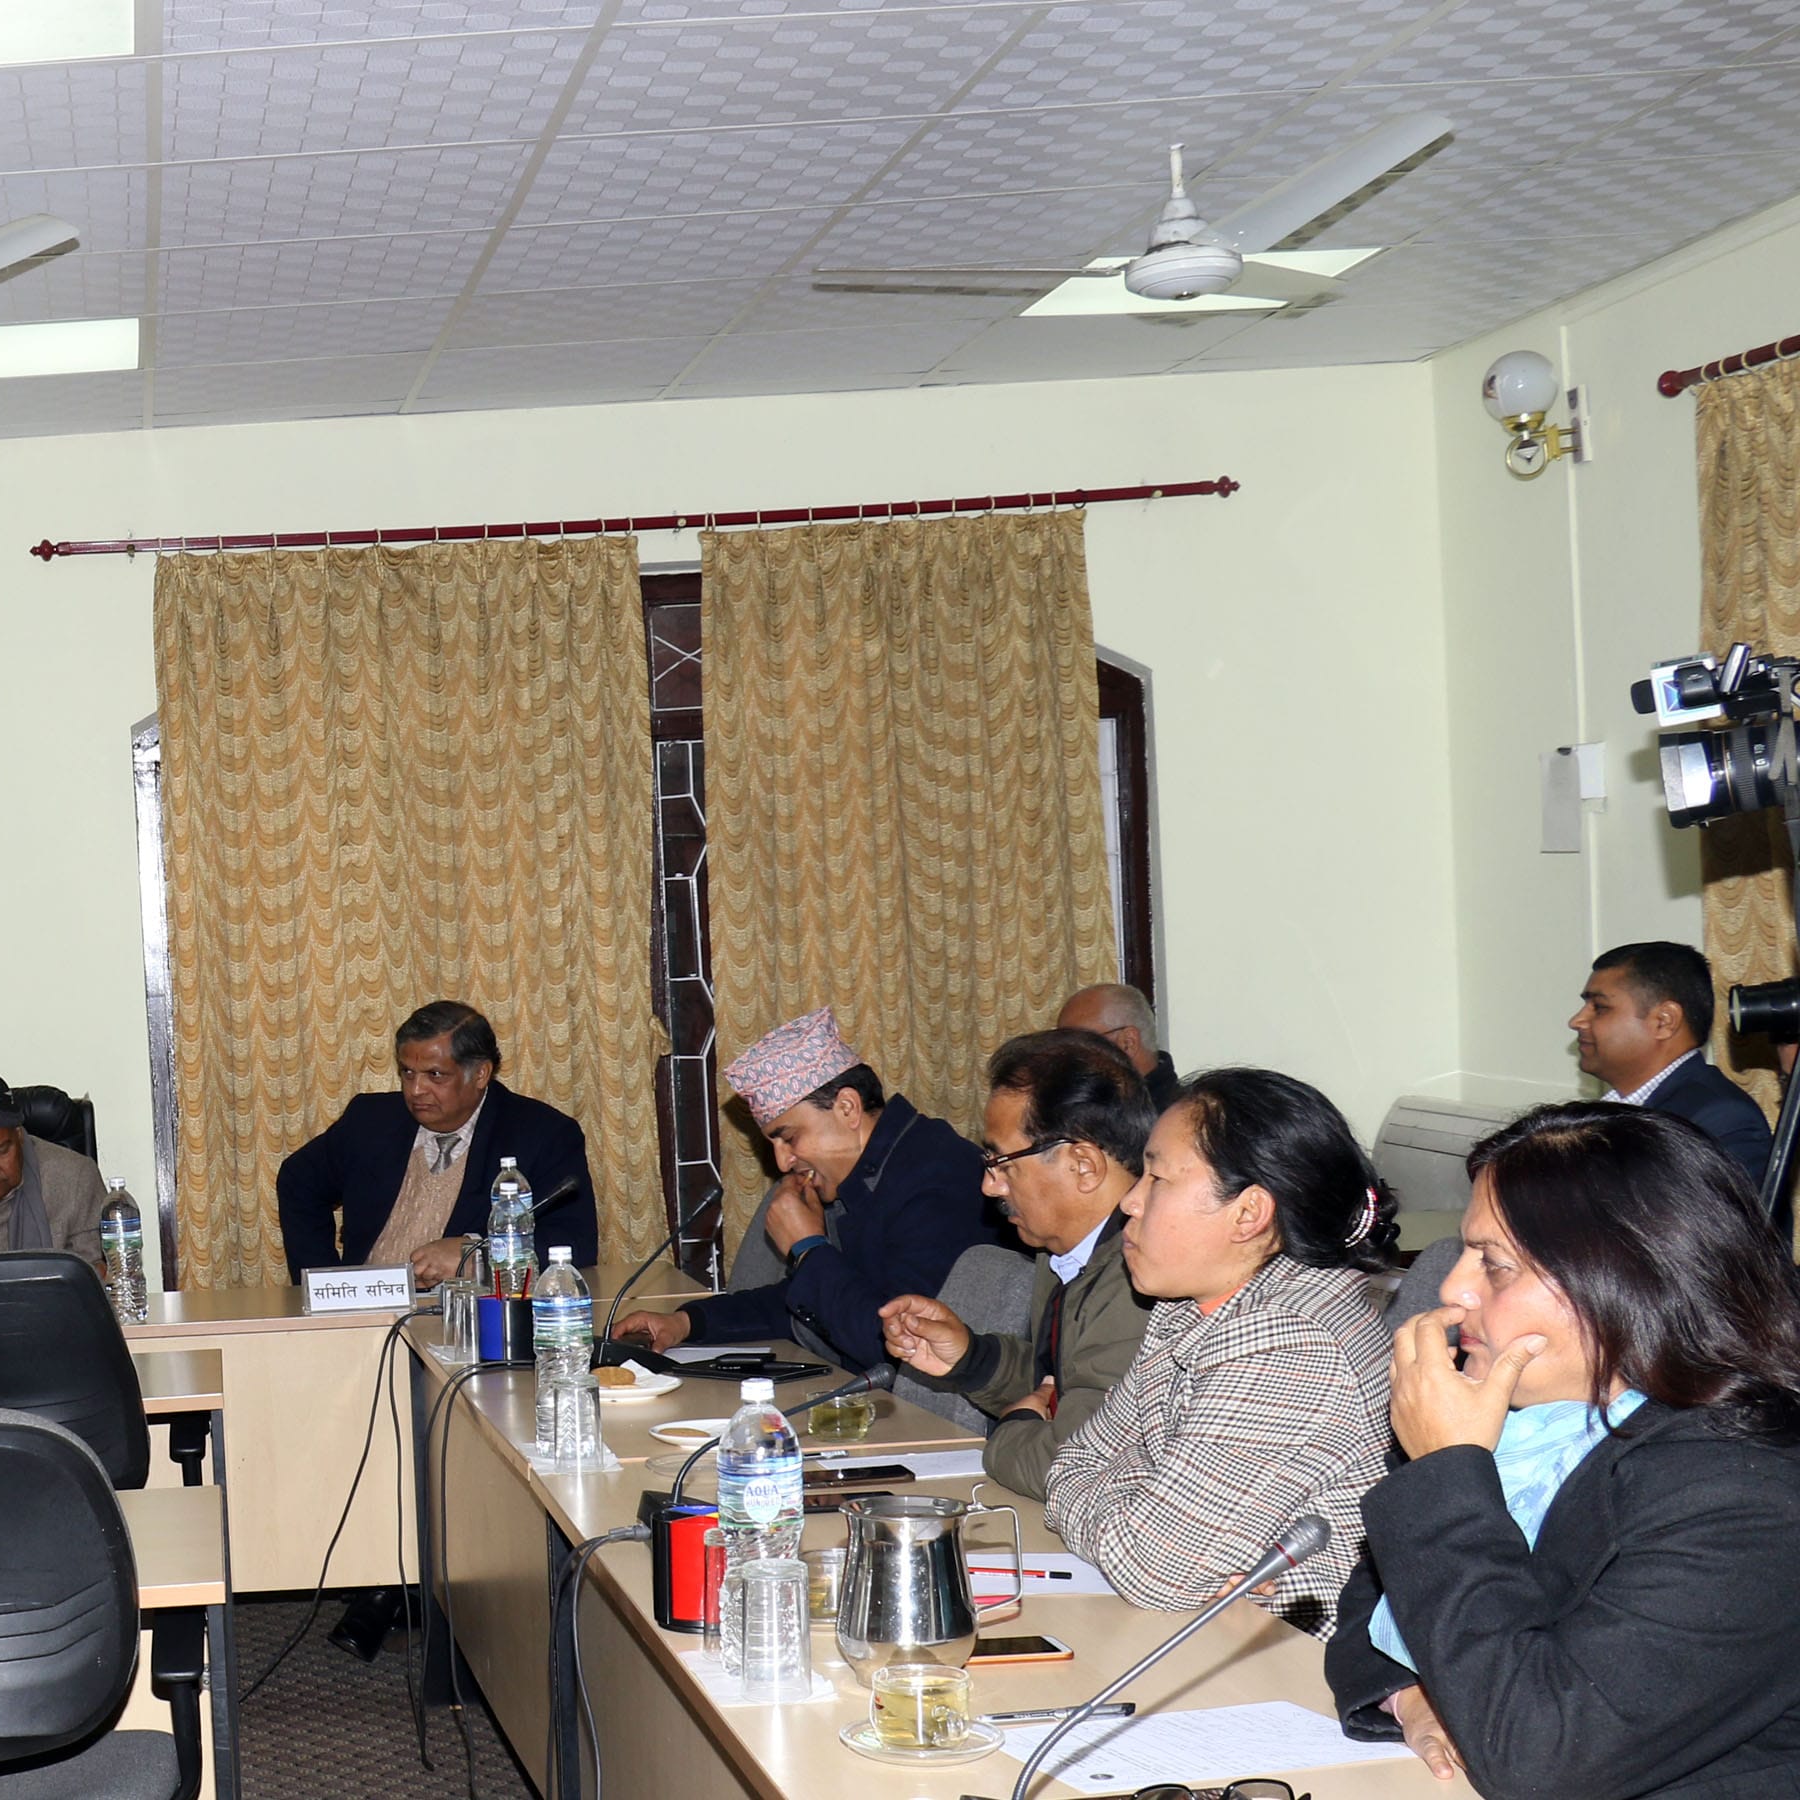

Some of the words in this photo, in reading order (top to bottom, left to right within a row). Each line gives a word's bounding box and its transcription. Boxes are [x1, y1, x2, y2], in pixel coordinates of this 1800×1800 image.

[313, 1281, 358, 1299] समिति
[365, 1279, 406, 1297] सचिव
[746, 1484, 780, 1497] AQUA
